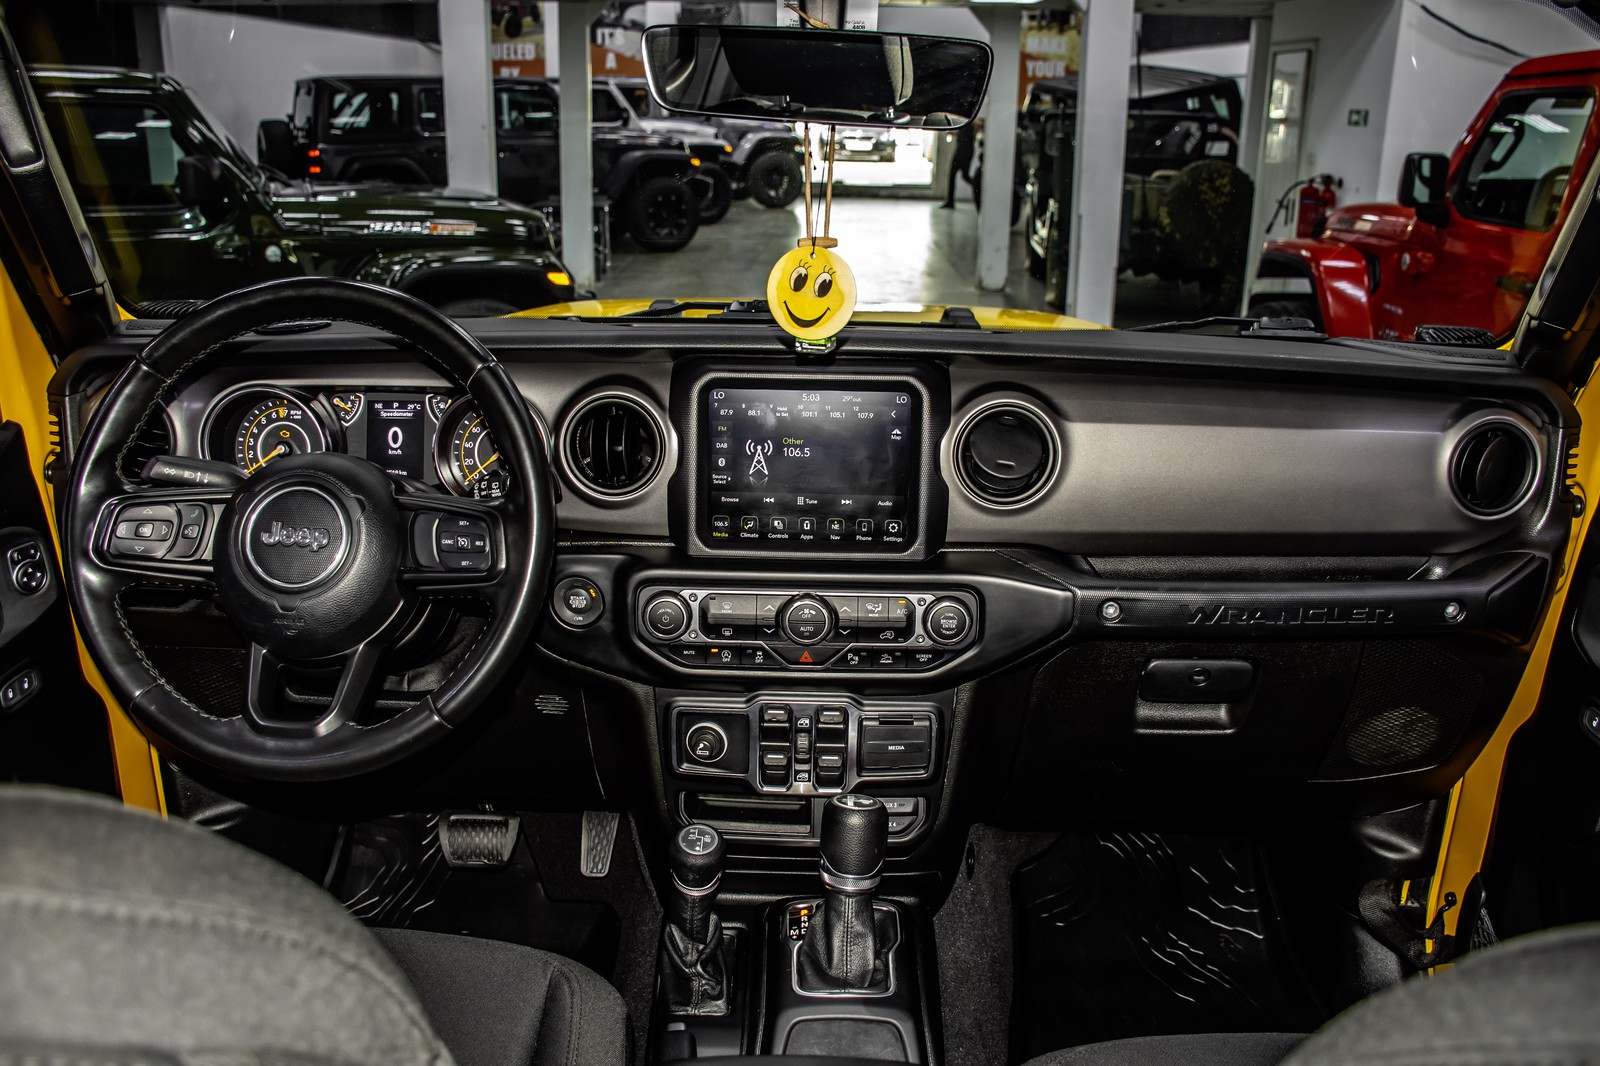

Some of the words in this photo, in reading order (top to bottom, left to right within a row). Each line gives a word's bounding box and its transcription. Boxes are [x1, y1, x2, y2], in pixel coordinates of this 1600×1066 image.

[596, 27, 624, 45] IT'S
[1026, 36, 1066, 54] MAKE
[492, 42, 536, 60] UELED
[605, 52, 617, 70] A
[1026, 60, 1066, 78] YOUR
[802, 393, 820, 401] 5:03
[387, 426, 403, 448] 0
[783, 448, 810, 457] 106.5
[261, 521, 330, 552] Jeep
[1180, 605, 1394, 626] WRANGLER
